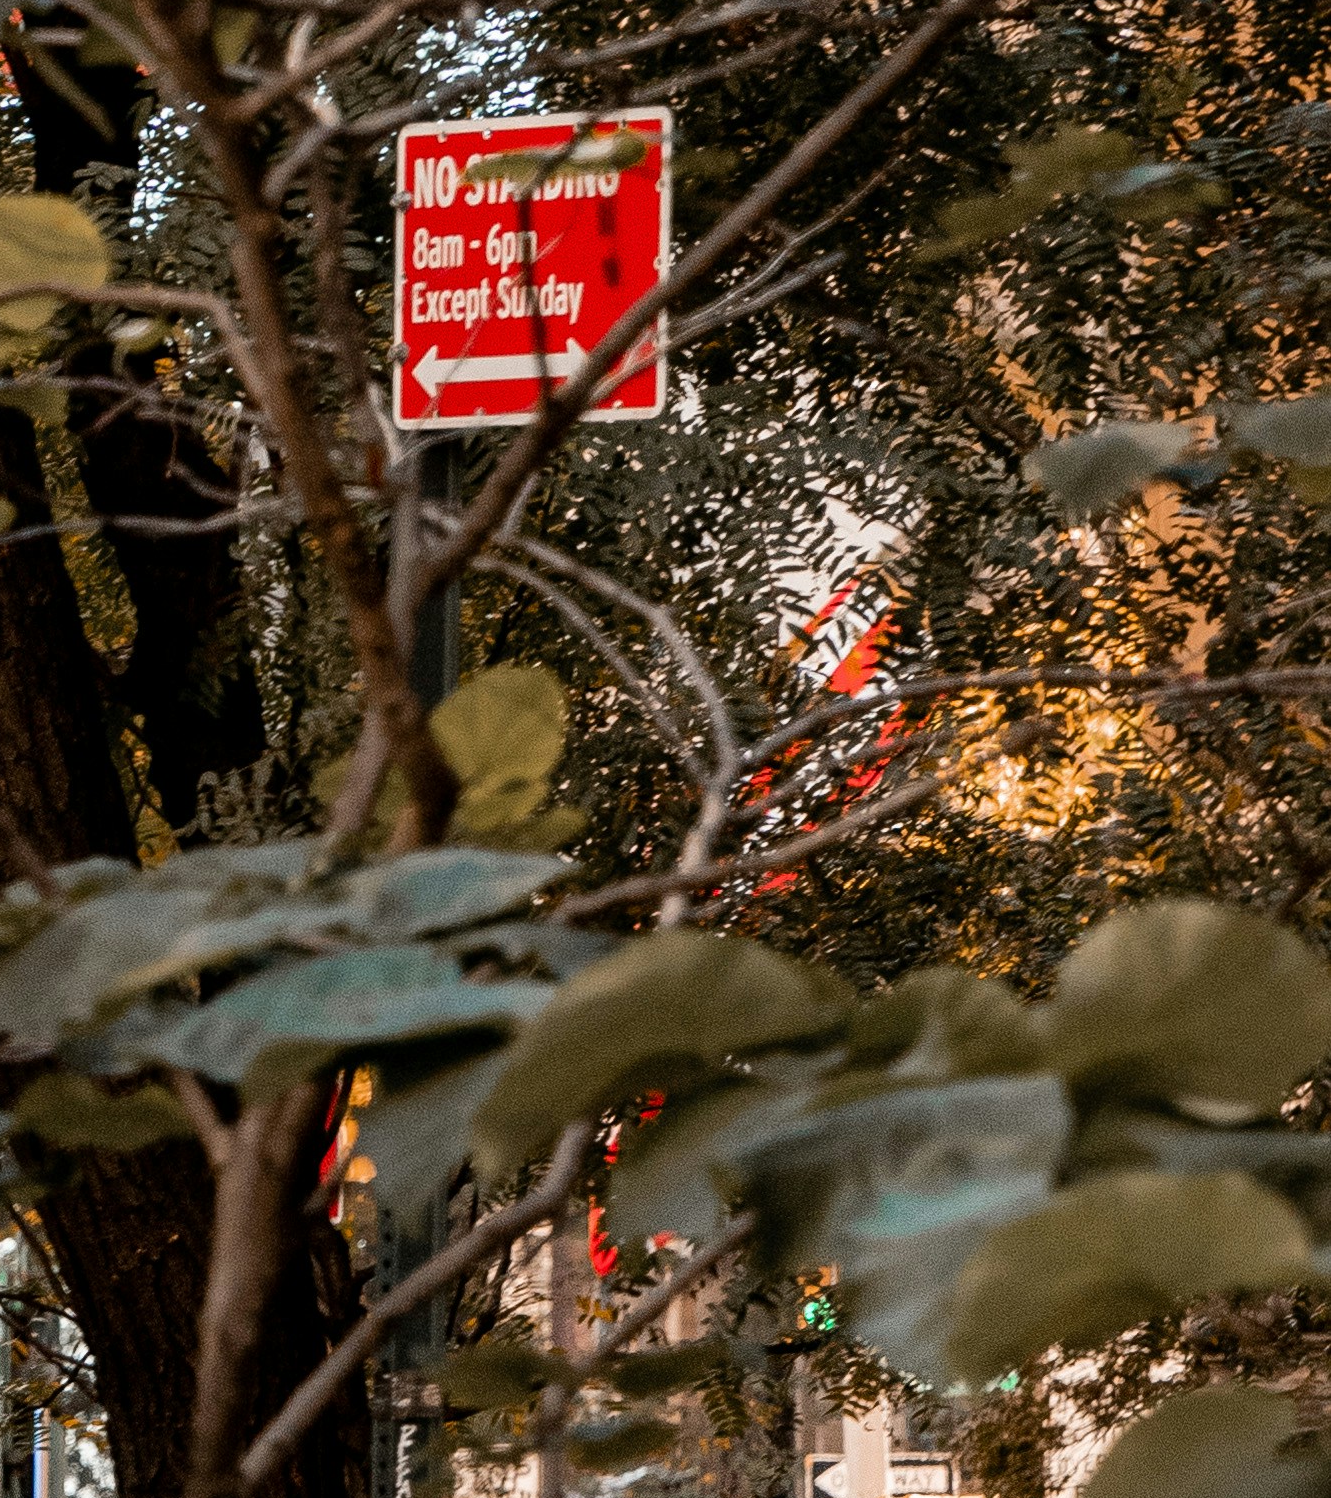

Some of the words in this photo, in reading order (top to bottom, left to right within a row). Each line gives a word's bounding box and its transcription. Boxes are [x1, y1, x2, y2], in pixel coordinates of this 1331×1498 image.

[413, 155, 457, 209] NO
[464, 152, 620, 206] STADING
[412, 226, 464, 270] 8am
[485, 223, 538, 273] 6pm
[411, 277, 491, 330] Except
